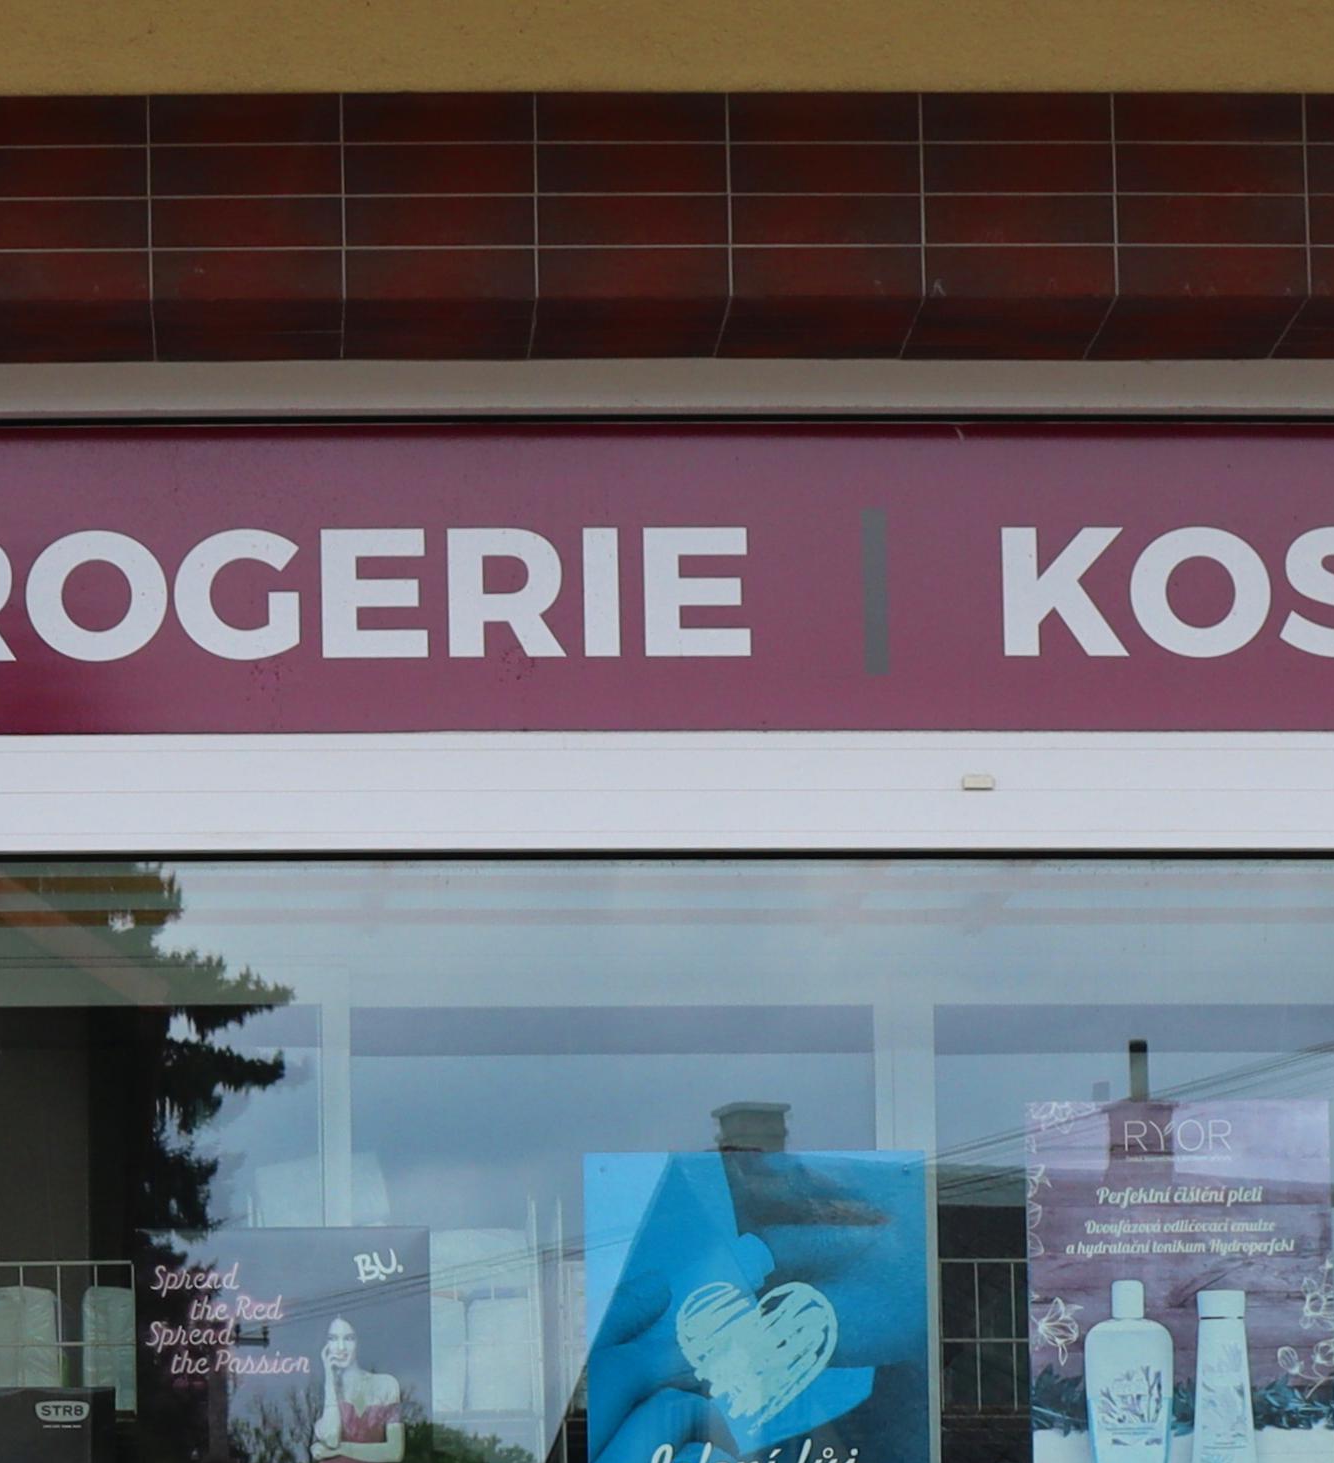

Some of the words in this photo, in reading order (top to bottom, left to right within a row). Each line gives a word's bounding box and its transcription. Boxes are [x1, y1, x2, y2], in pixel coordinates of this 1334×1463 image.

[1123, 1118, 1232, 1152] RYOR
[1096, 1186, 1170, 1208] Perfektní
[1226, 1186, 1264, 1207] pleti
[150, 1262, 240, 1298] Spread
[189, 1296, 230, 1321] the
[236, 1294, 285, 1321] Red
[146, 1319, 236, 1353] Spread
[171, 1350, 210, 1375] the
[215, 1350, 311, 1375] Passion
[40, 1404, 84, 1417] STR8
